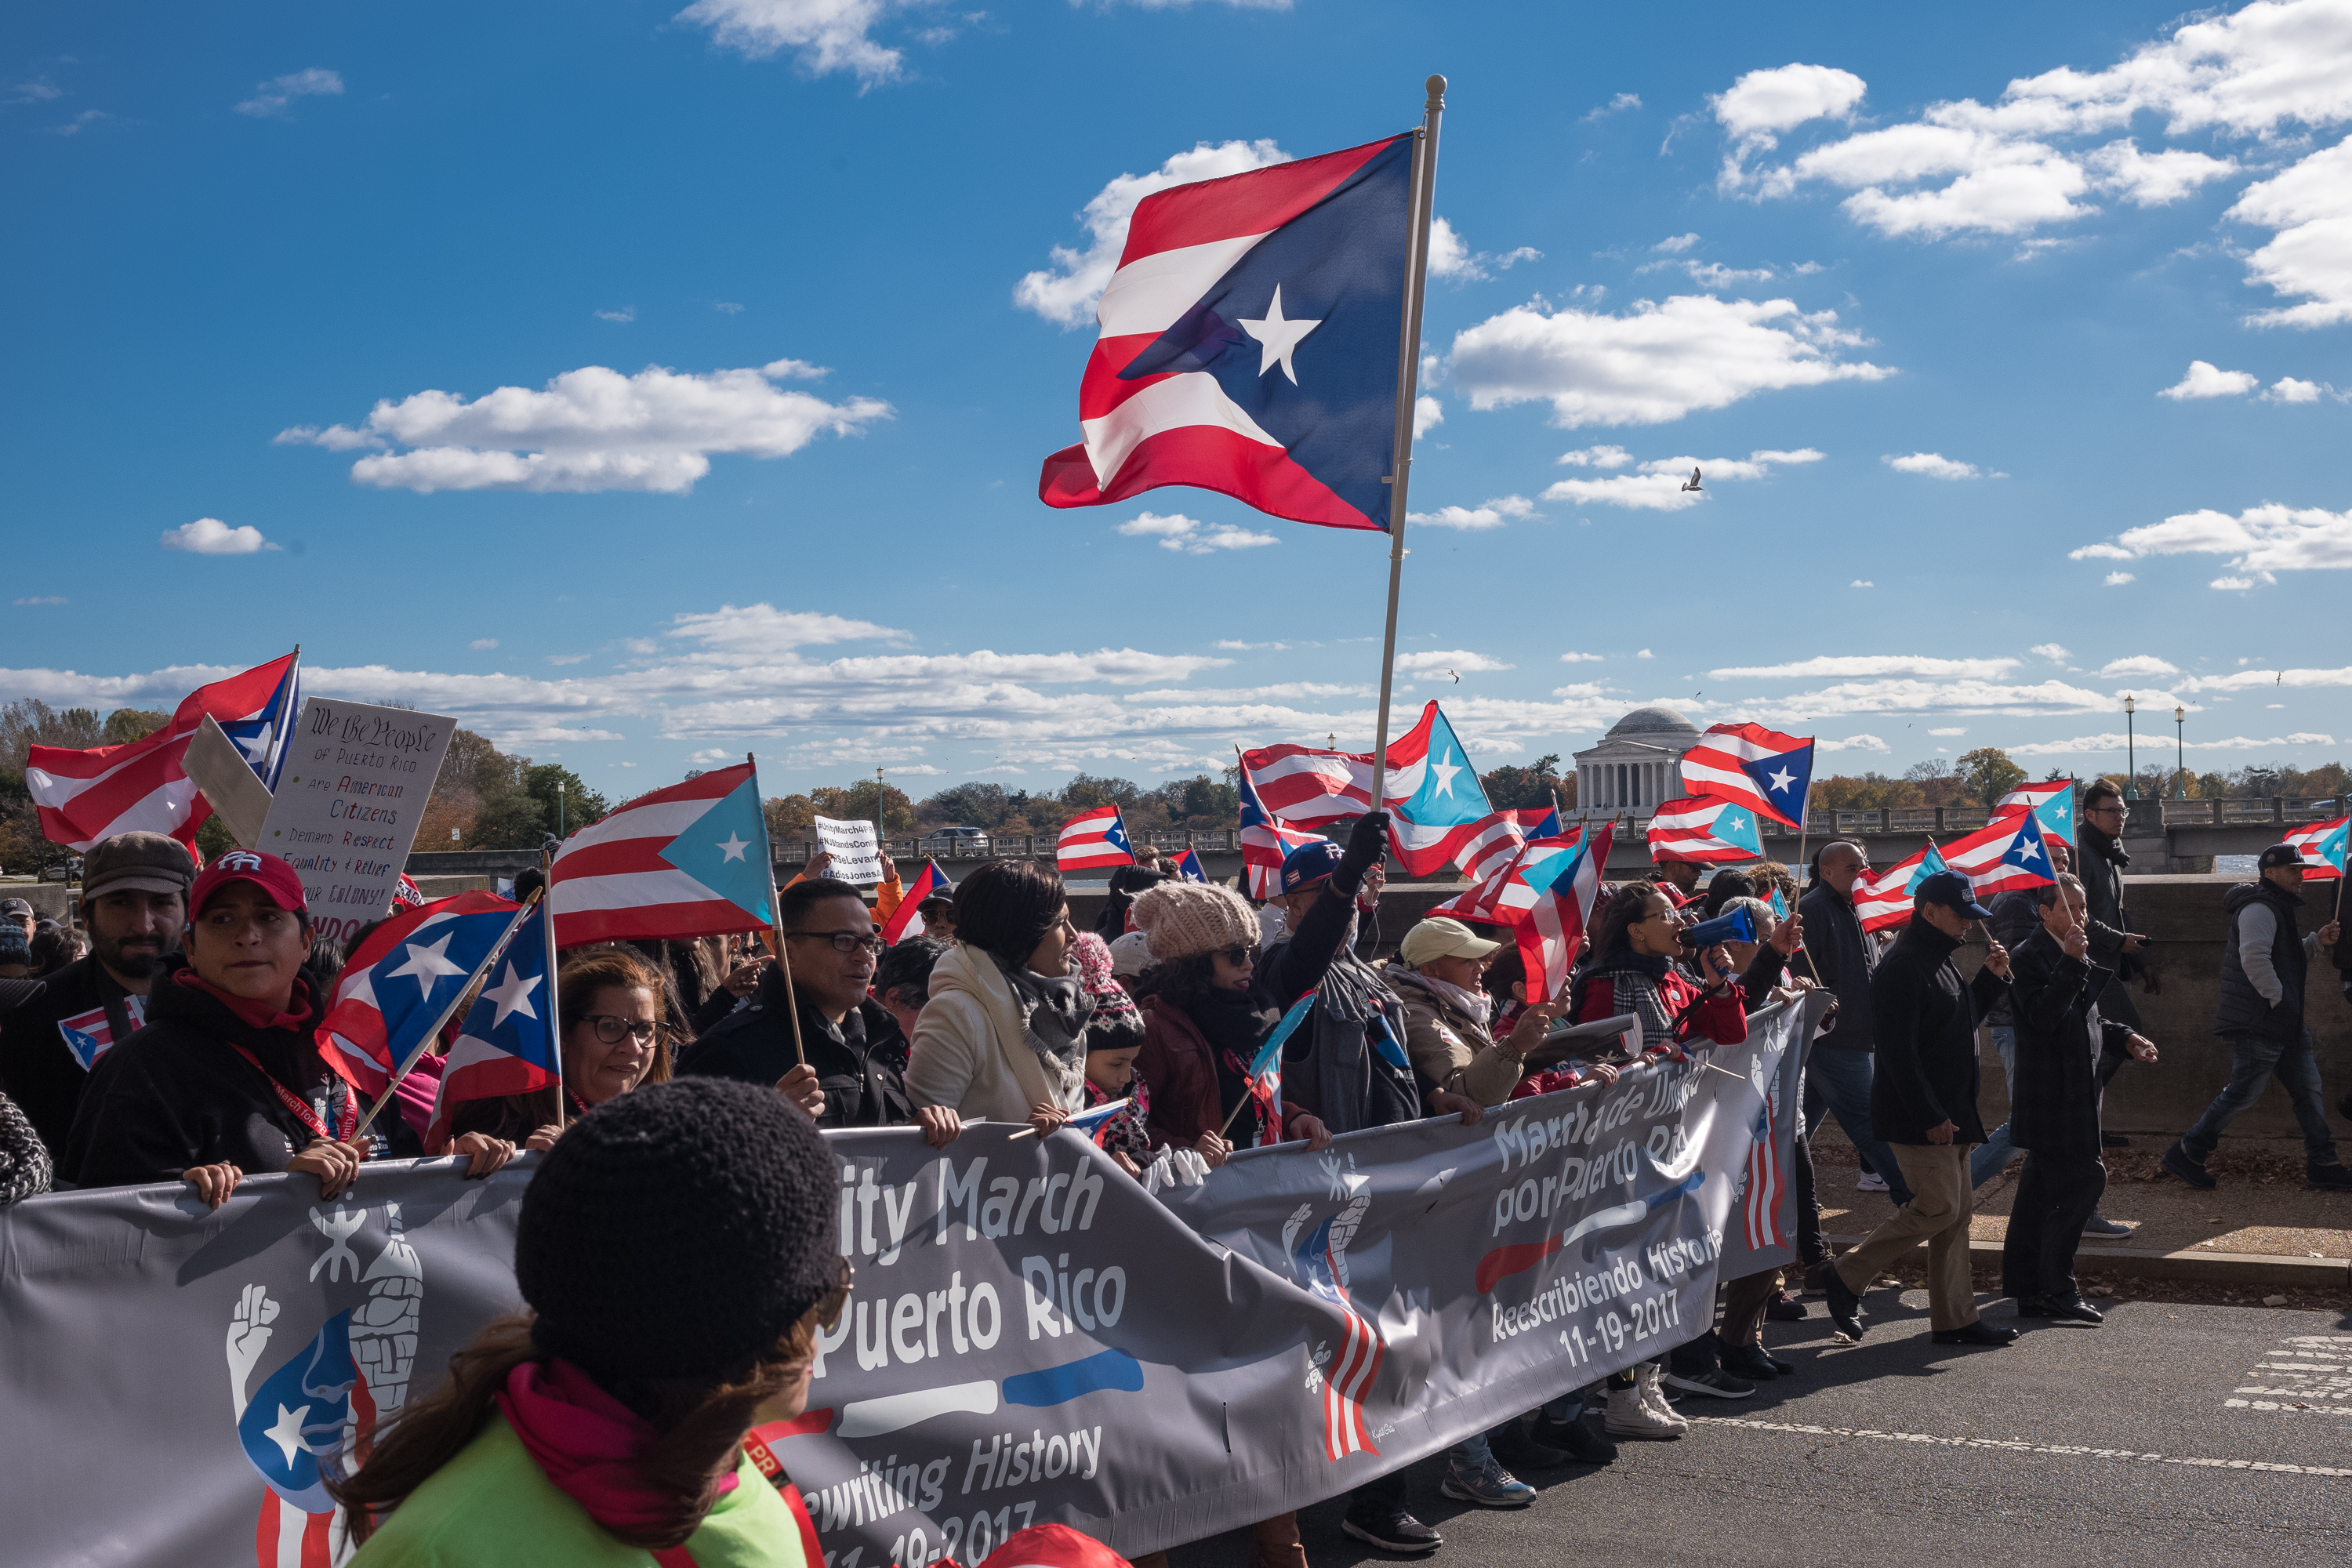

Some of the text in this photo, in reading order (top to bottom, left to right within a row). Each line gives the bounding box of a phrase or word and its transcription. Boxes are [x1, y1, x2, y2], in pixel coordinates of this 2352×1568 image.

[310, 707, 436, 753] We the People
[315, 748, 330, 760] of
[275, 1087, 302, 1112] March
[300, 1109, 315, 1123] for
[314, 1117, 328, 1135] PR
[341, 1116, 355, 1141] Unity
[1494, 1100, 1605, 1173] Marcha
[1604, 1085, 1644, 1132] de
[840, 1155, 1104, 1266] ity March
[1493, 1175, 1556, 1237] por
[1556, 1137, 1638, 1209] Puerto
[812, 1253, 1127, 1379] Puerto Rico
[1492, 1225, 1723, 1344] Reescribiendo Historia
[1560, 1288, 1679, 1367] 11-19-2017
[749, 1445, 776, 1475] PR
[803, 1425, 1102, 1533] ewriting History
